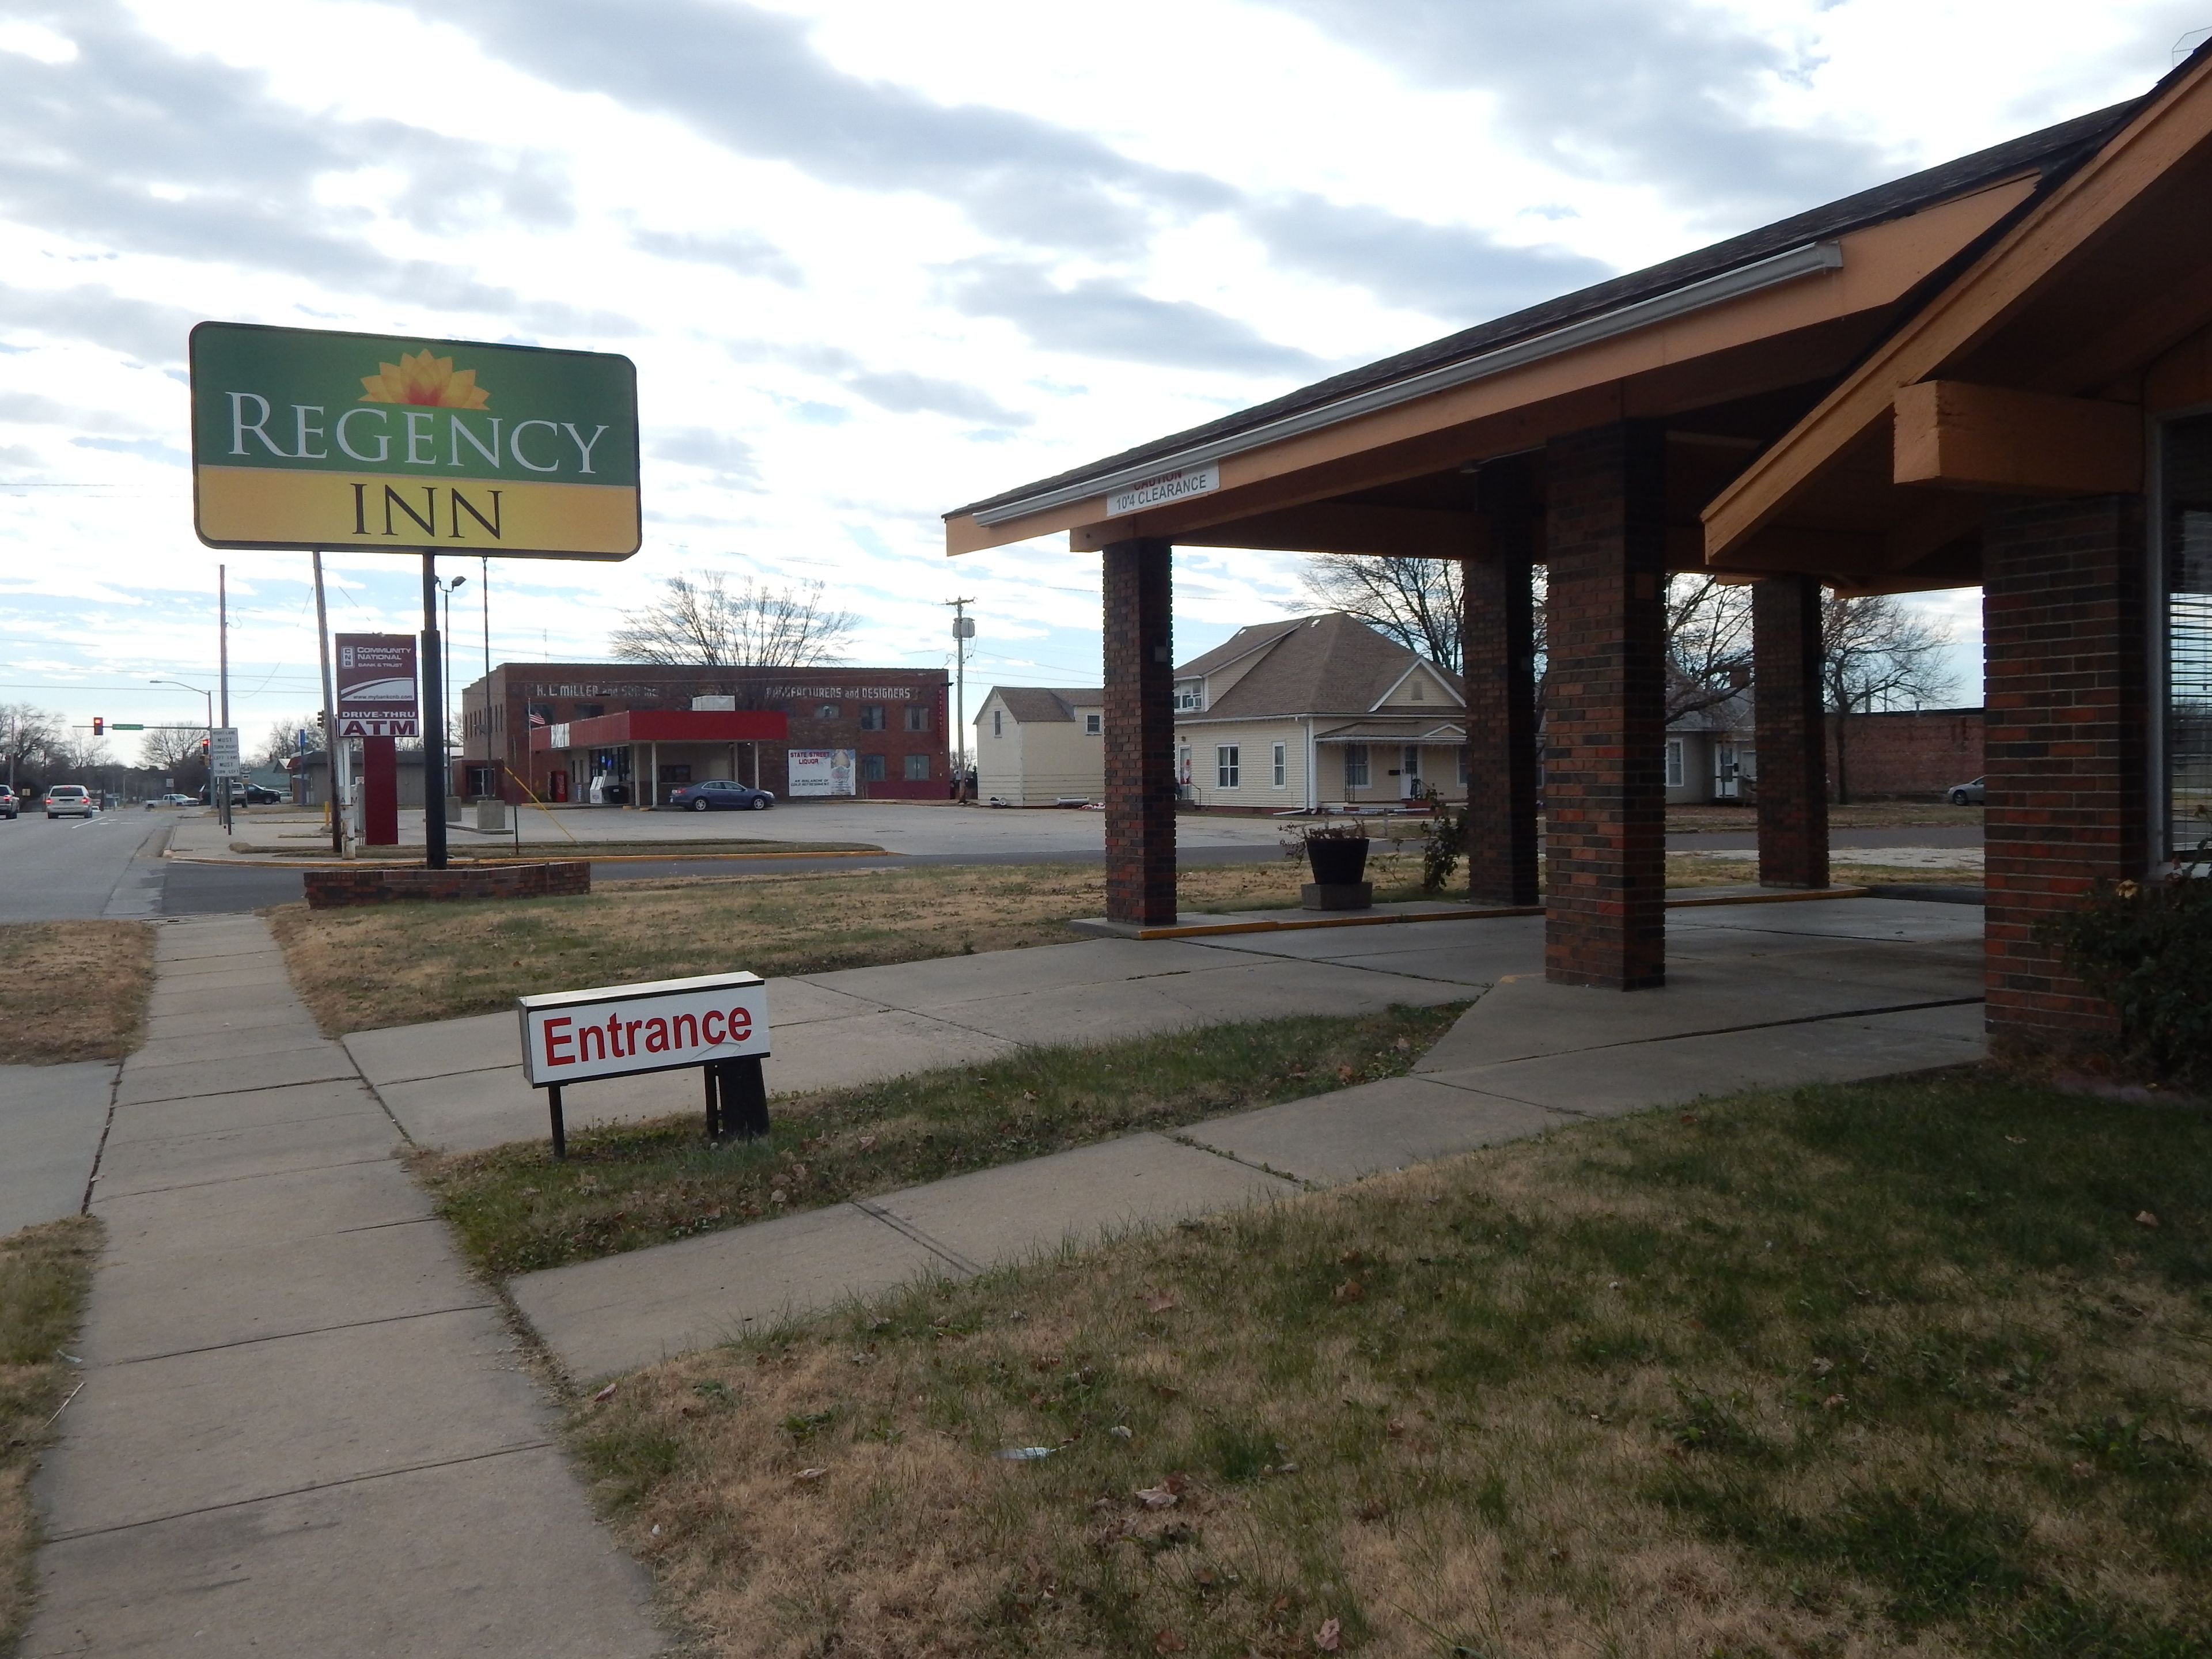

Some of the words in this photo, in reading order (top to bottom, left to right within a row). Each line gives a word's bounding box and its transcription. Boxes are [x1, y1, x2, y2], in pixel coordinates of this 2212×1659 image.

[225, 391, 609, 474] REGENCY
[1116, 493, 1135, 510] 10'4
[1138, 475, 1206, 505] CLEARANCE
[351, 483, 502, 540] INN
[560, 684, 599, 696] MILLER
[845, 688, 859, 698] and
[862, 688, 910, 698] DESIGNERS
[343, 721, 415, 735] ATM
[543, 1007, 752, 1067] Entrance
